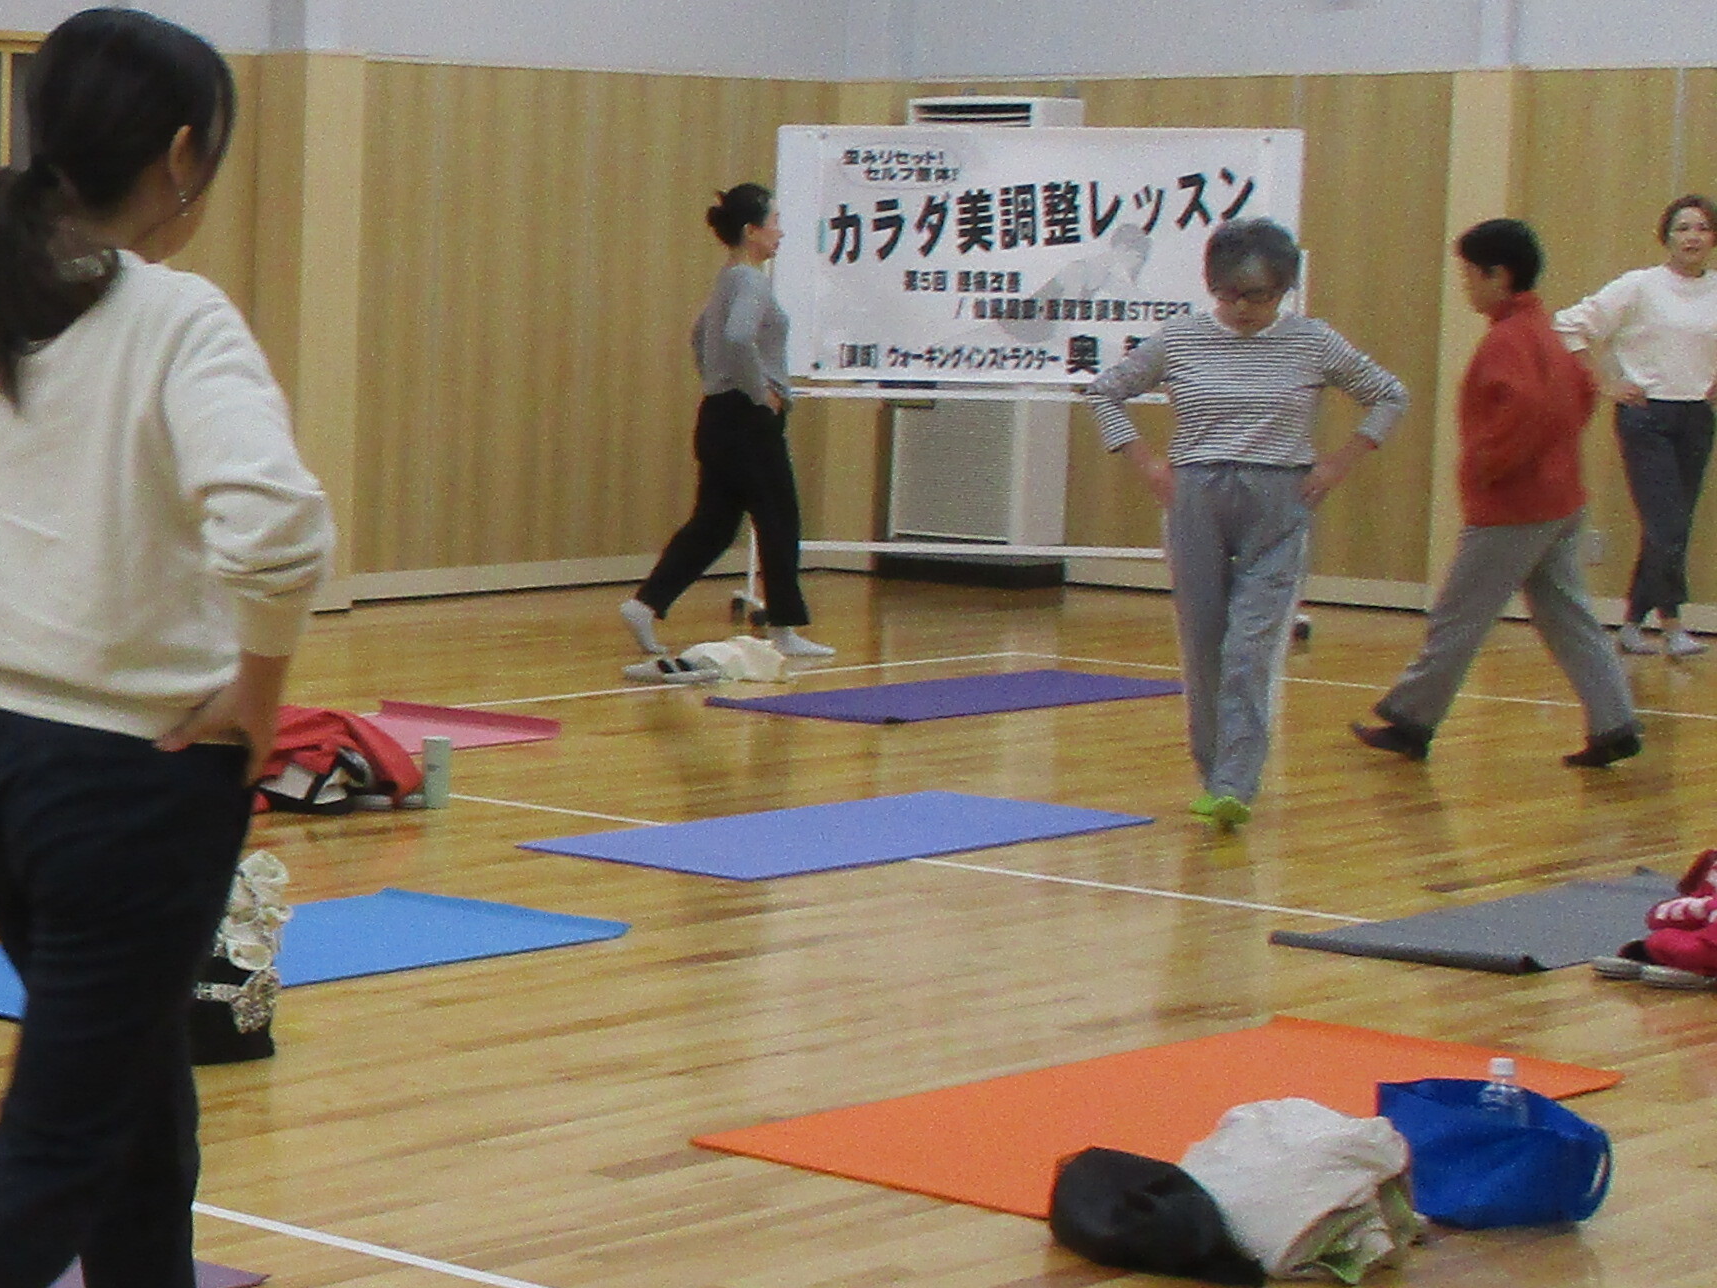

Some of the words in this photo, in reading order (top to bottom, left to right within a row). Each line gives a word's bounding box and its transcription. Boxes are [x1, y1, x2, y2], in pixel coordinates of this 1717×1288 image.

[828, 167, 1256, 266] カラダ美調整レッスン
